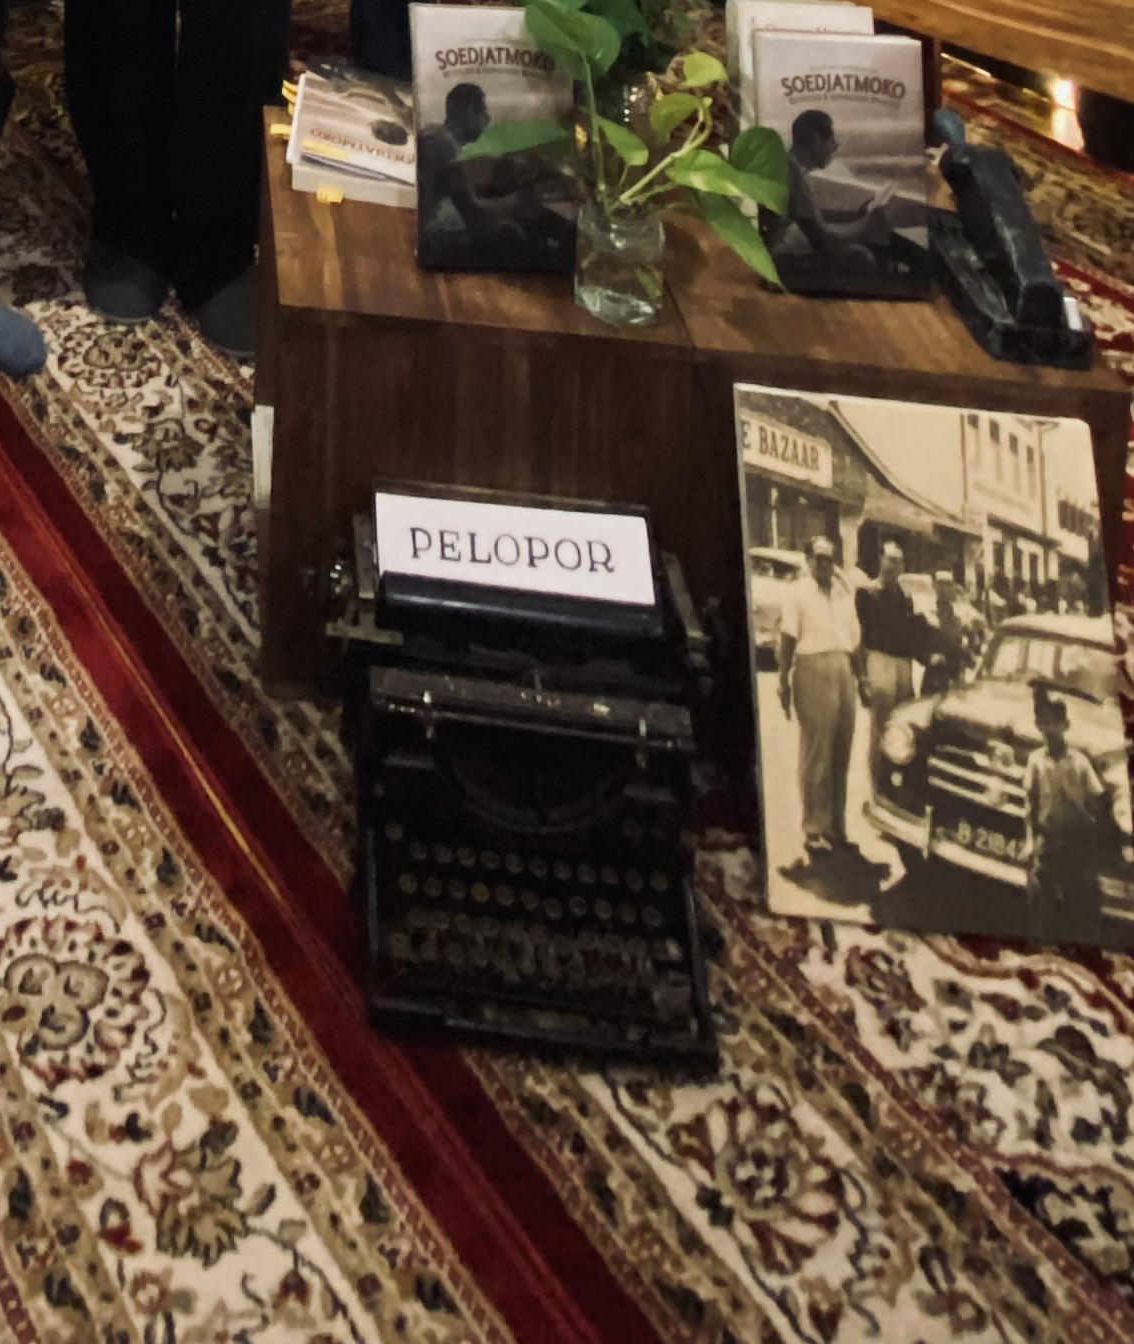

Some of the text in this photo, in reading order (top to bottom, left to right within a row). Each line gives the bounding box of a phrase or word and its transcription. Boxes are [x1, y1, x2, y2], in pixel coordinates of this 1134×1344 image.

[434, 46, 555, 72] SOEDJATMOKO
[780, 73, 907, 99] SOEDJATMOKO
[758, 425, 820, 472] BAZAAR
[409, 526, 615, 574] PELOPOR
